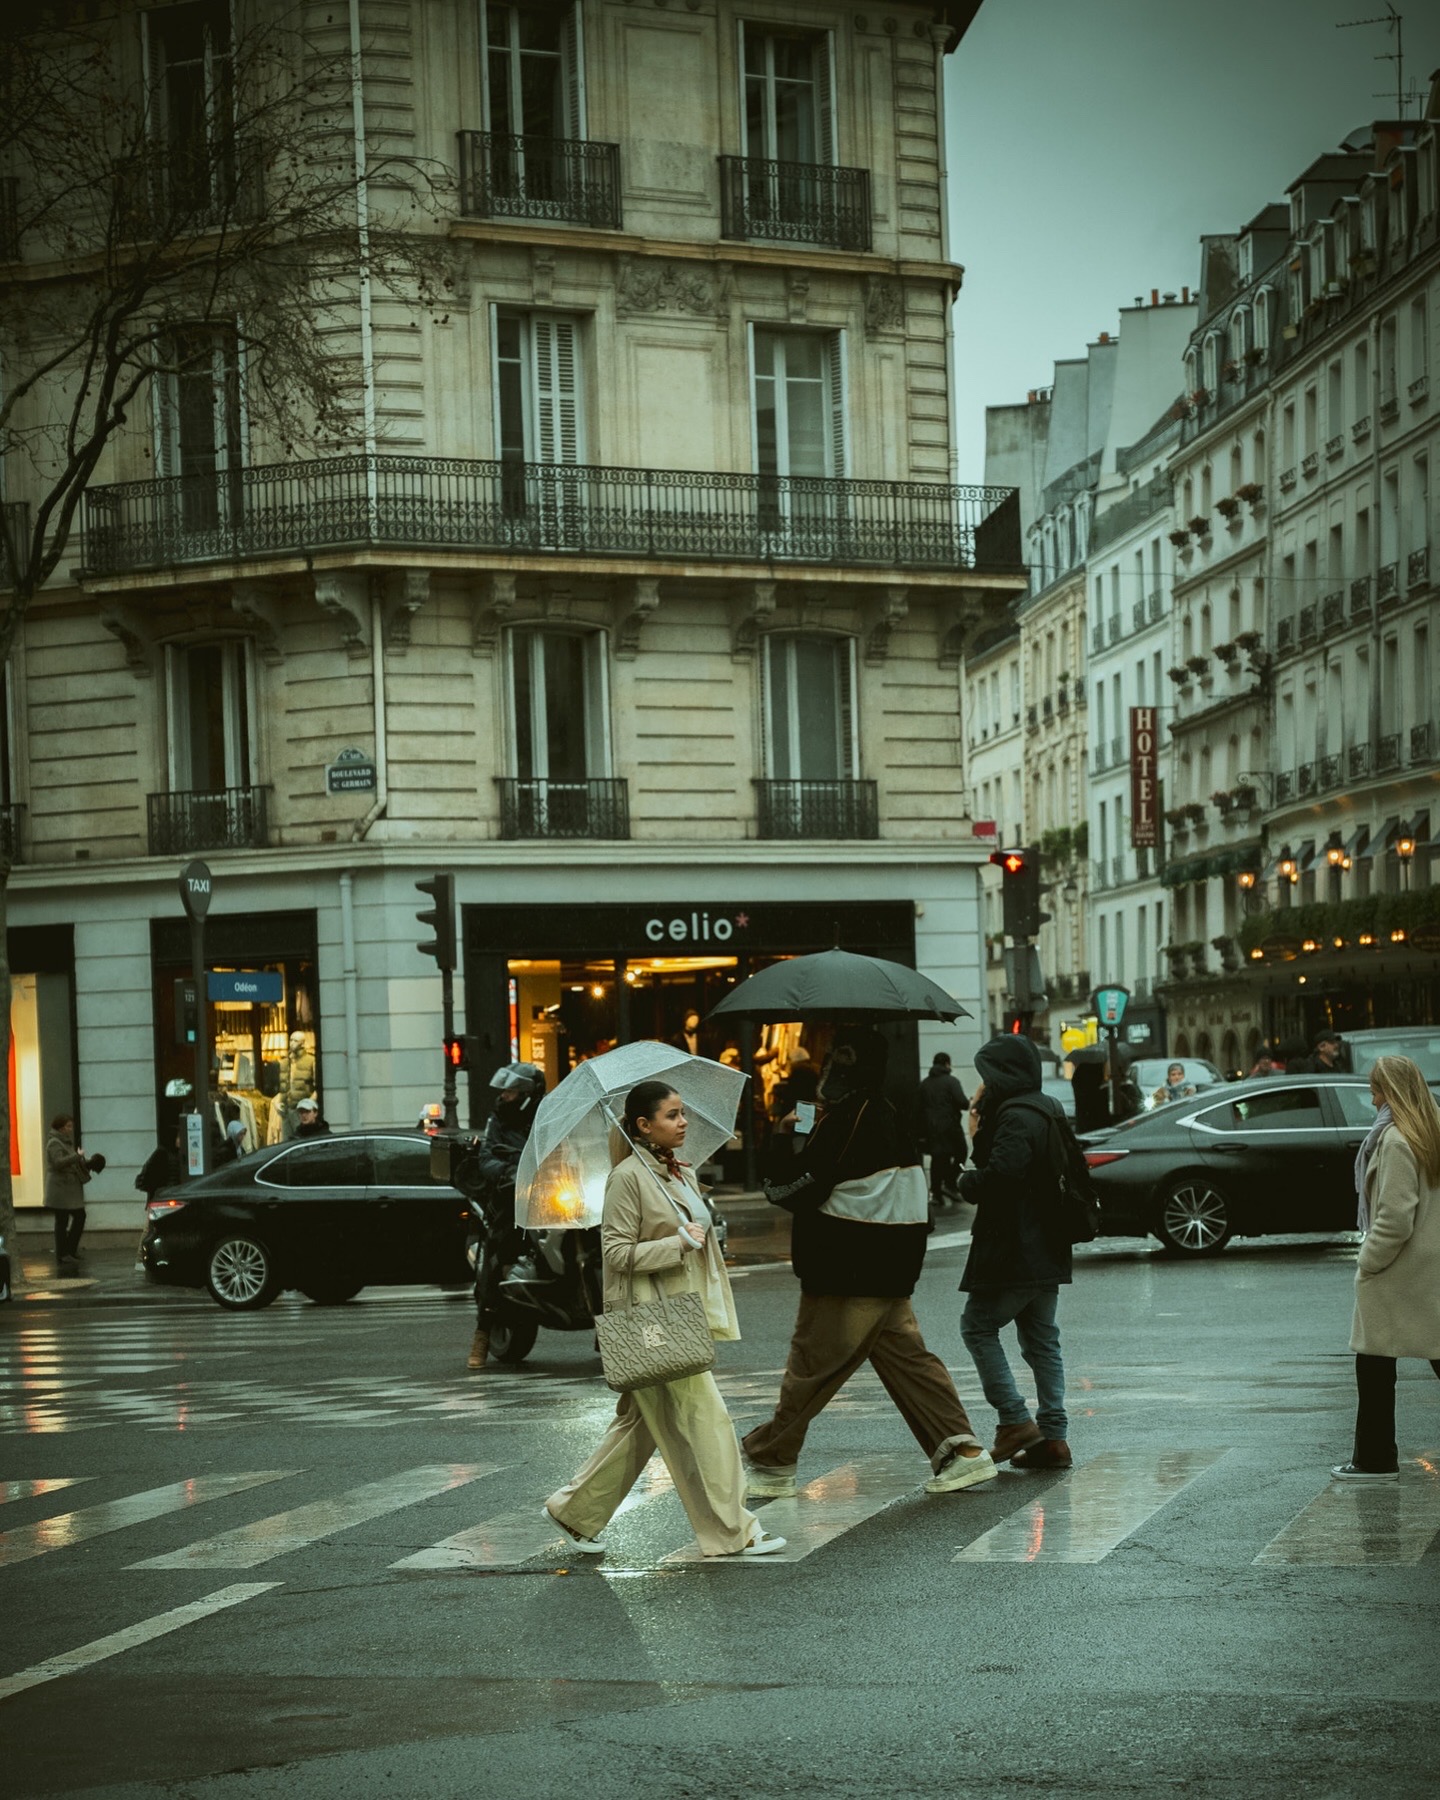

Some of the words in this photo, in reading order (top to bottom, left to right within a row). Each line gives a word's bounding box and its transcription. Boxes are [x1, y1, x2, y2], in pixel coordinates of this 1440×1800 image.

[1136, 708, 1152, 824] HOTEL
[331, 768, 371, 778] BOULEVARD
[341, 779, 371, 788] GERMAIN
[187, 878, 210, 893] TAXI
[645, 912, 732, 941] celio
[234, 981, 258, 992] Odéon
